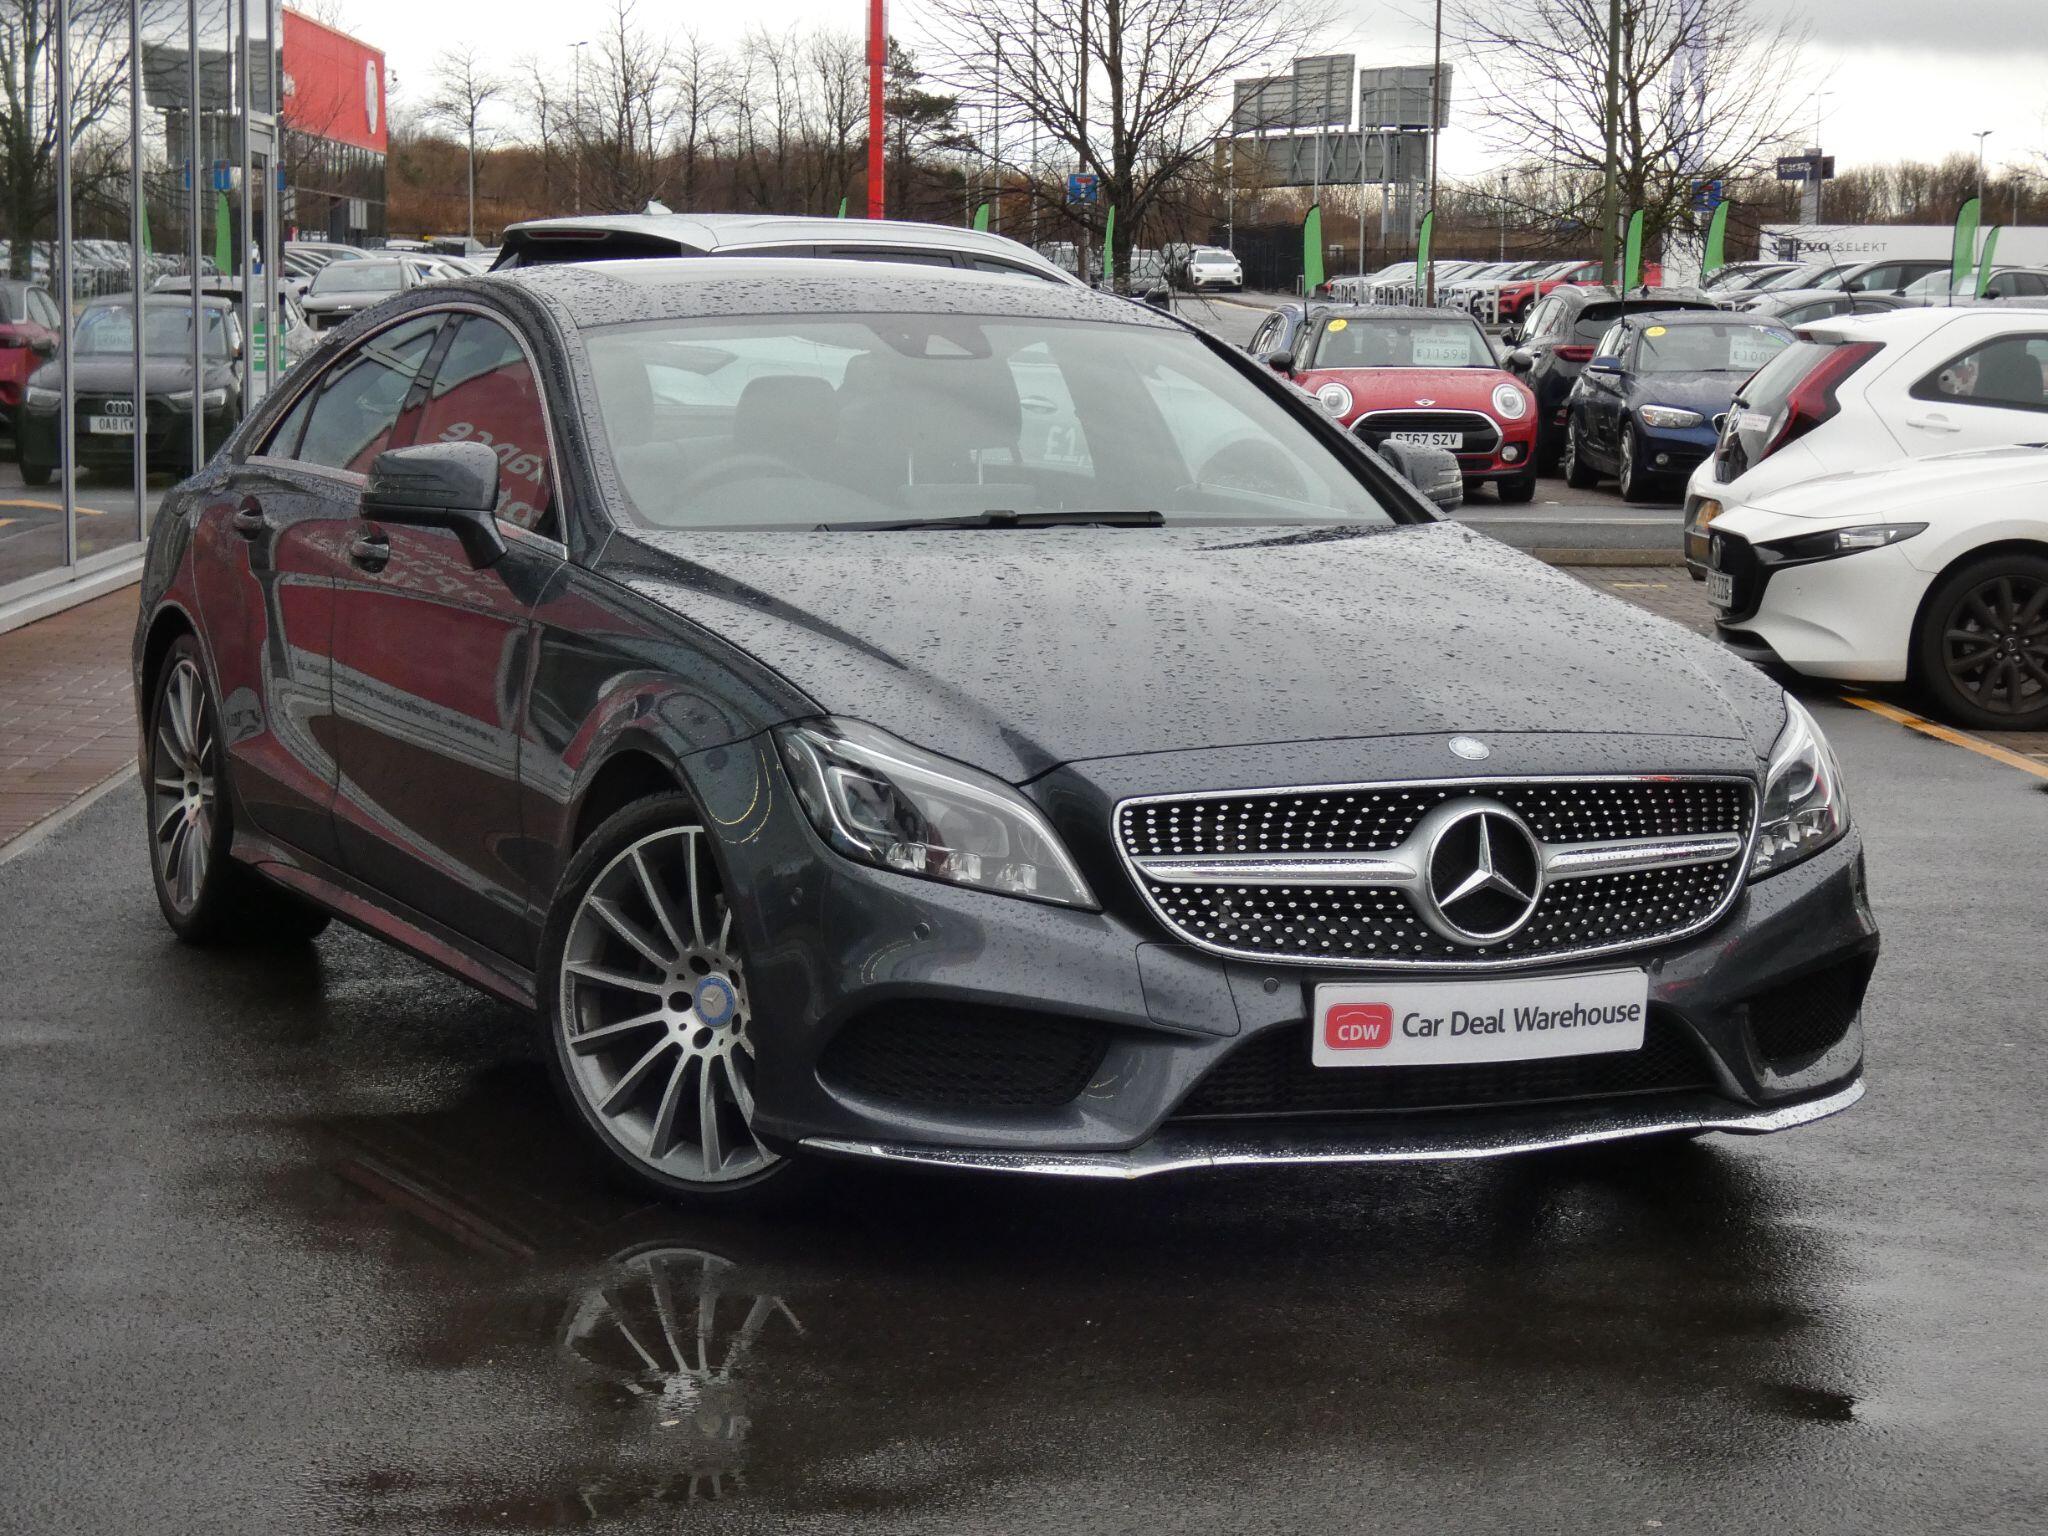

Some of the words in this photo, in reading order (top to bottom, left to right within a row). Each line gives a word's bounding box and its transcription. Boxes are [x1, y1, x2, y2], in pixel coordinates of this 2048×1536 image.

[1836, 242, 1888, 252] SELEKT
[1395, 433, 1429, 446] ST67
[1432, 433, 1457, 446] SZV
[1402, 1012, 1444, 1037] Car
[1450, 1008, 1505, 1036] Deal
[1513, 1002, 1641, 1032] Warehouse
[1337, 1023, 1380, 1042] CDW
